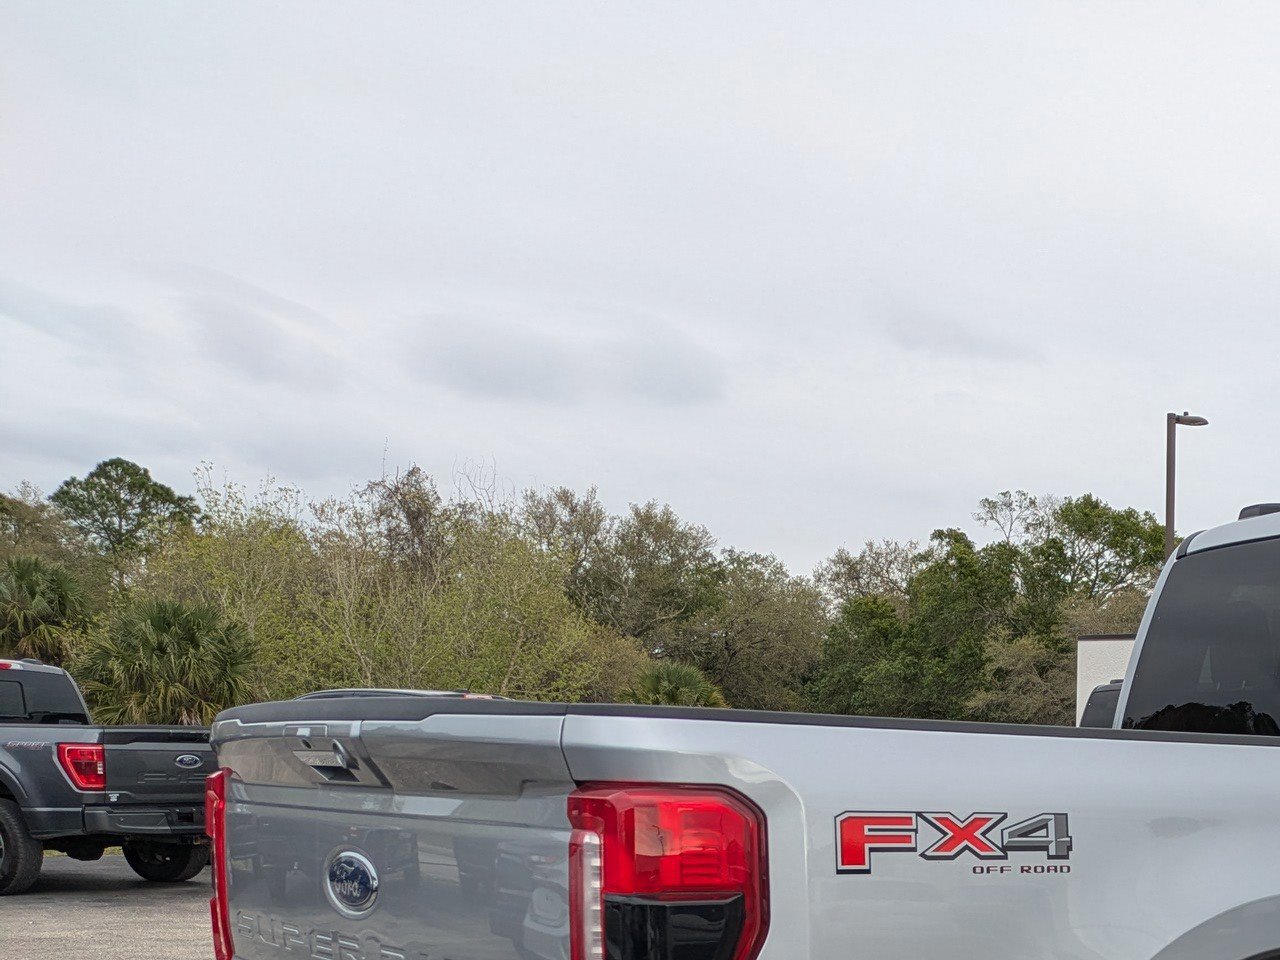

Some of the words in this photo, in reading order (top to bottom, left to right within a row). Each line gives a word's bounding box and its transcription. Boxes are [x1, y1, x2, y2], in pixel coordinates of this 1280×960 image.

[834, 810, 1073, 875] FX4
[333, 862, 362, 898] Ford
[972, 865, 1012, 875] OFF
[1020, 864, 1071, 874] ROAD
